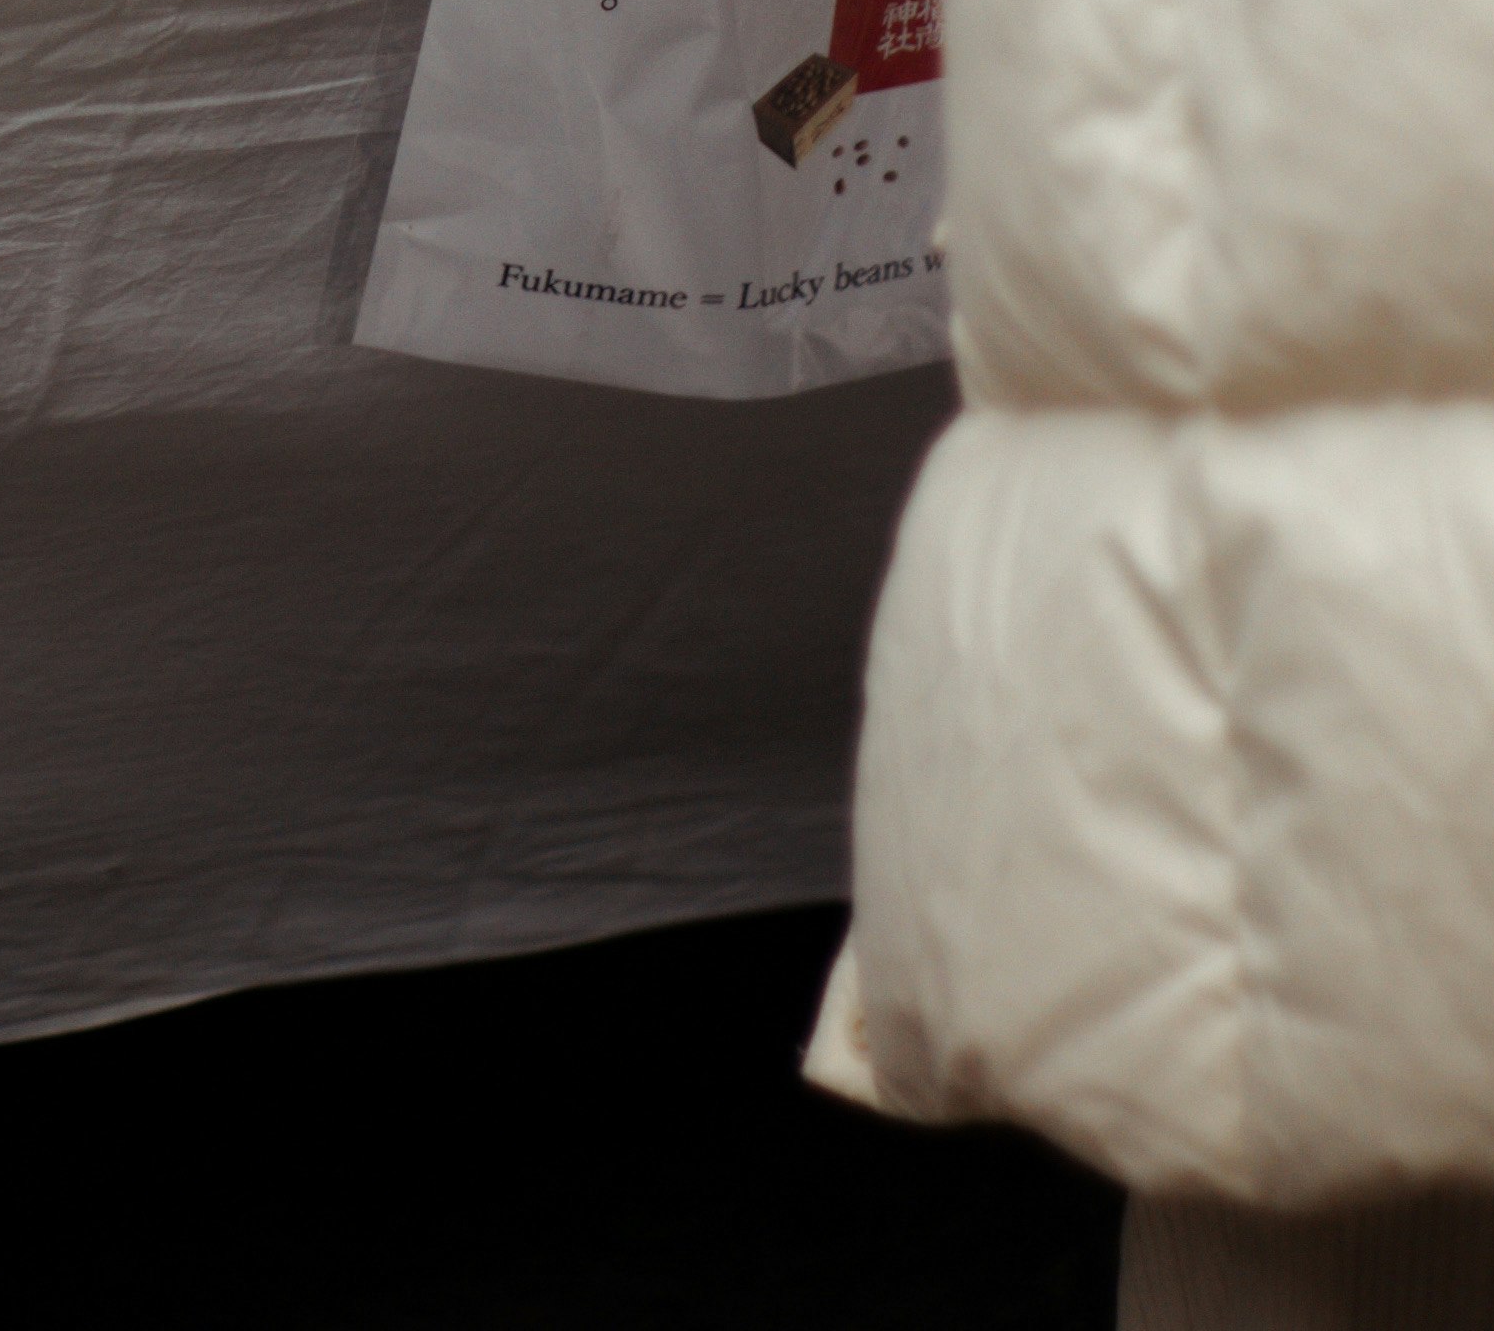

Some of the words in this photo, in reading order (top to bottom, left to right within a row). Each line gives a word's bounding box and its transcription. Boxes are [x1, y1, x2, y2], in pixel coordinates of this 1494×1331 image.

[498, 263, 688, 311] Fukumame
[737, 270, 825, 314] Lucky
[833, 253, 914, 293] beans
